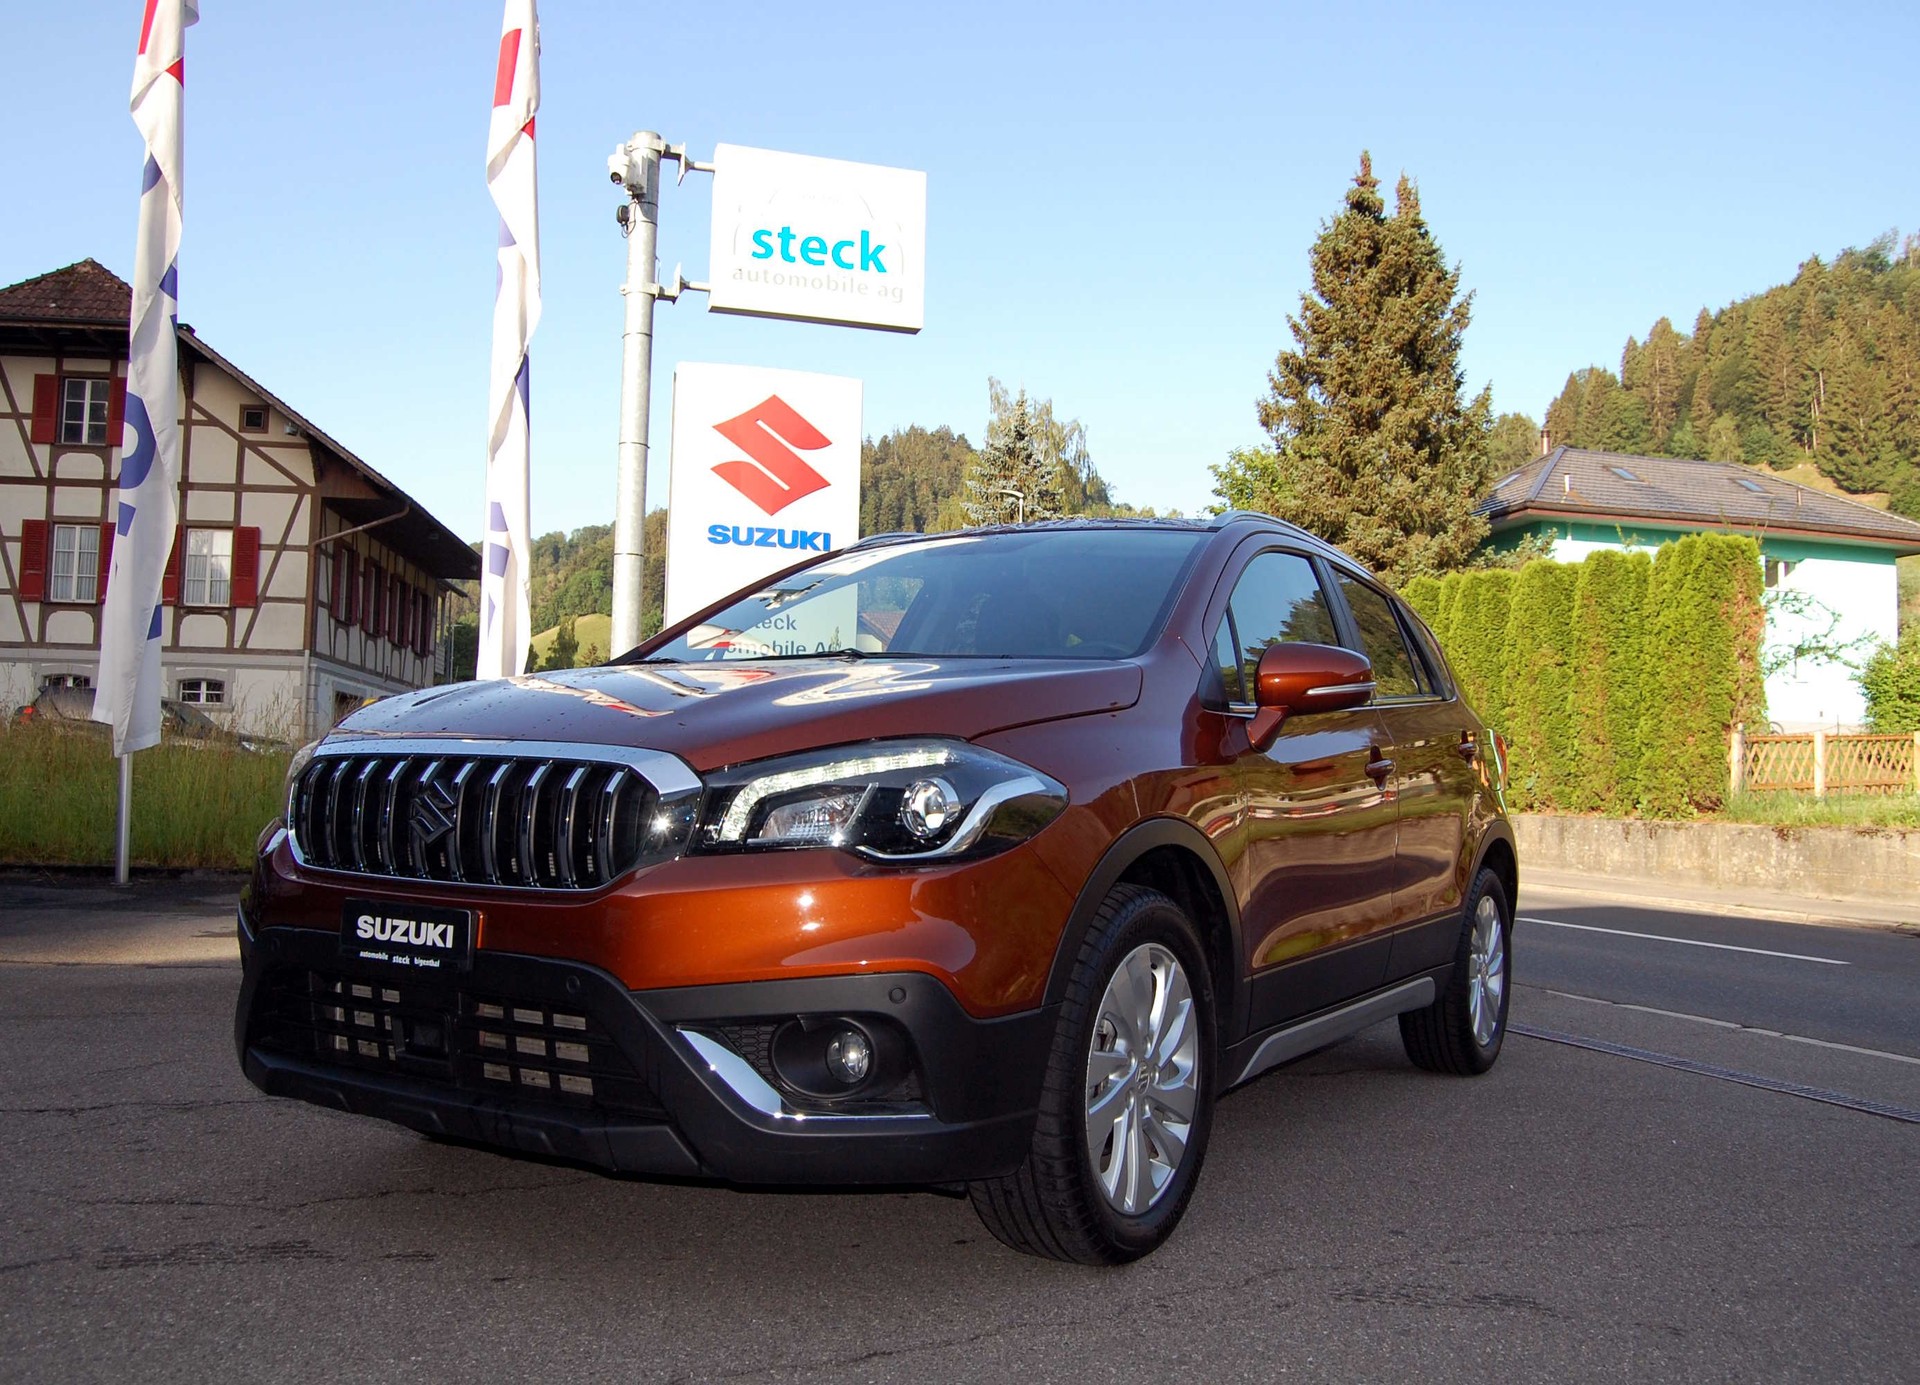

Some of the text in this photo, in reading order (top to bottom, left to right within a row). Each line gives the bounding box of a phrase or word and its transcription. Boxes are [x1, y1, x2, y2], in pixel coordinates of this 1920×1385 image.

[752, 226, 887, 273] steck
[732, 266, 904, 304] automobile ag
[707, 524, 832, 552] SUZUKI
[356, 915, 454, 948] SUZUKI
[392, 955, 410, 964] steck
